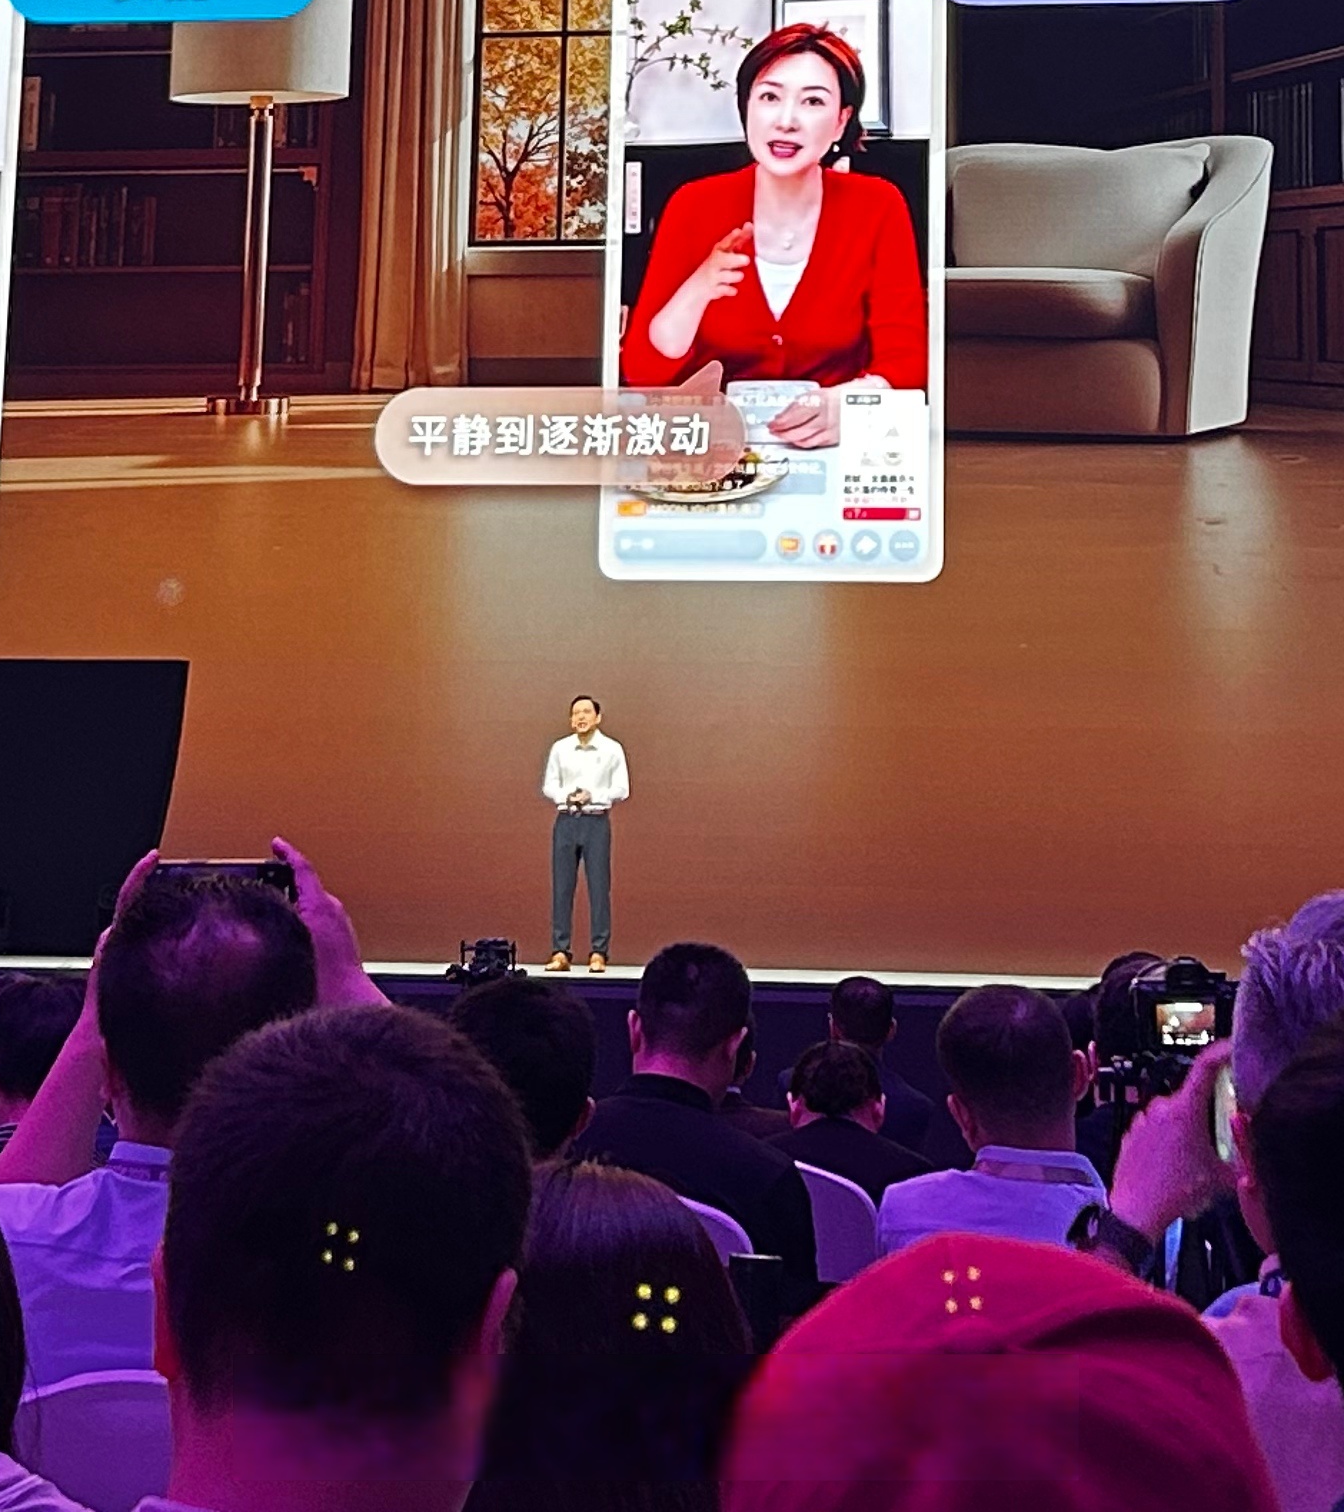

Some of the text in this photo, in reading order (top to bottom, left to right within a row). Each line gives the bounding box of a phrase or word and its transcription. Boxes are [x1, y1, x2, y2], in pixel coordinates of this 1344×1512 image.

[407, 412, 711, 457] 平静到逐渐激动
